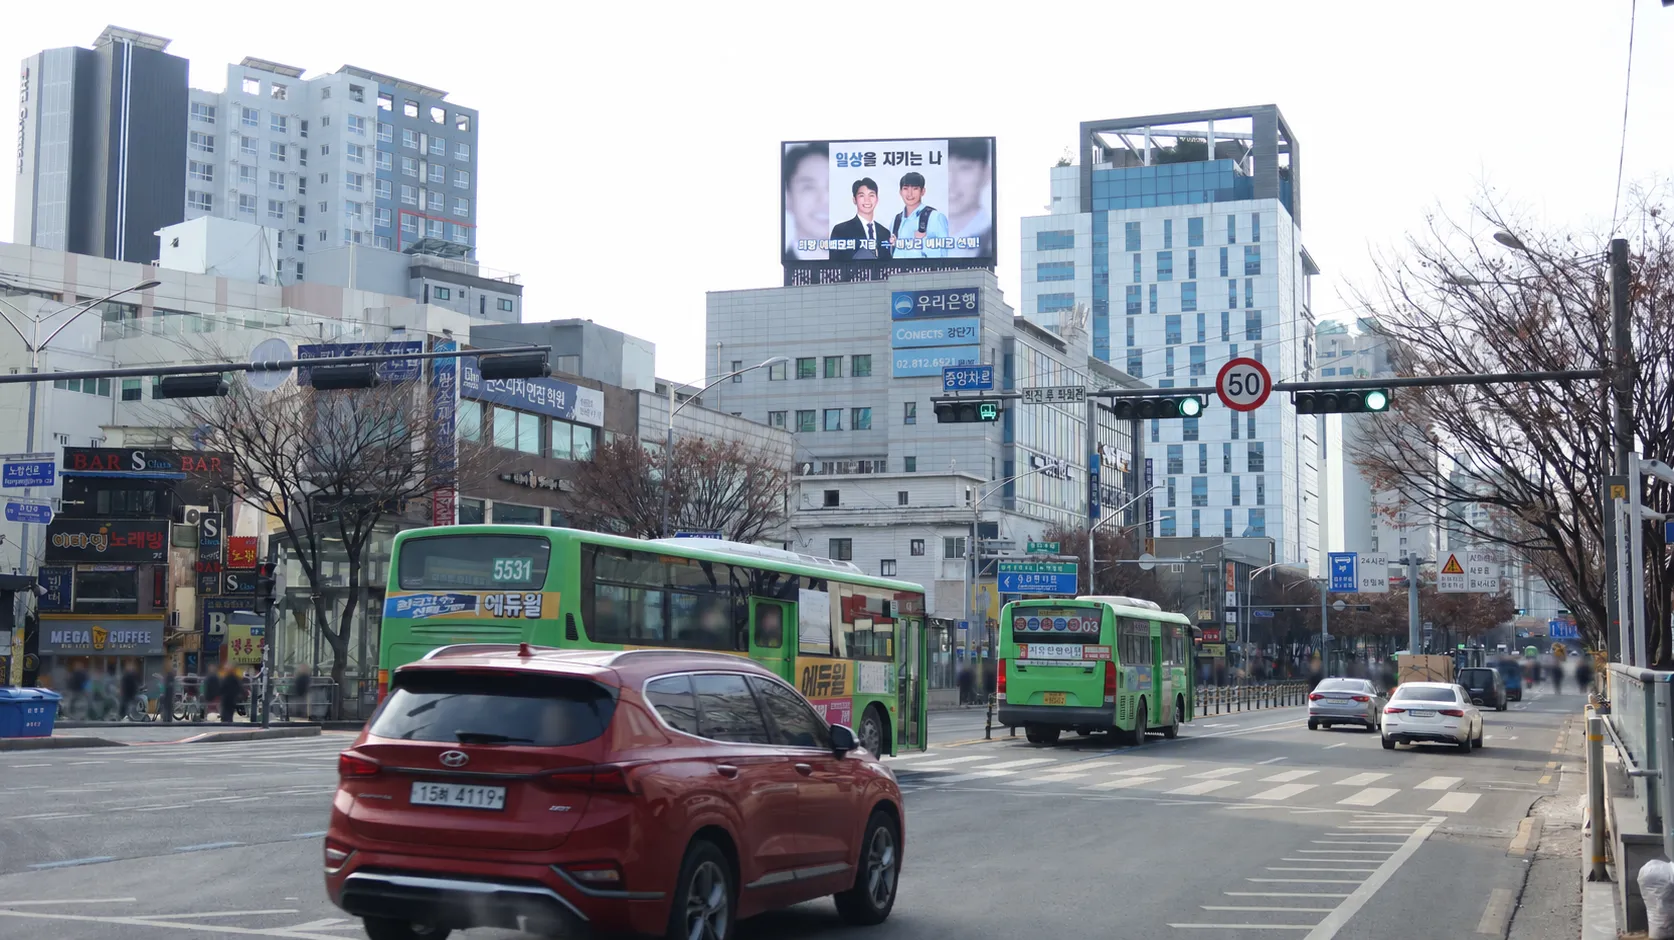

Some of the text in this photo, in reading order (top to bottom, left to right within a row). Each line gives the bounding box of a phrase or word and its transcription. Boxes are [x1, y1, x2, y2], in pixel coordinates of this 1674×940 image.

[835, 150, 943, 168] 일상을 지키는 나
[916, 292, 976, 312] 우리은행
[945, 370, 992, 387] 중앙차로
[1228, 373, 1260, 396] 50
[73, 453, 121, 470] BAR
[131, 450, 146, 471] S
[181, 456, 223, 473] BAR
[204, 518, 218, 537] S
[110, 531, 164, 551] 노래방
[493, 559, 532, 582] 5531
[1360, 557, 1385, 566] 24시간
[226, 574, 239, 591] S
[484, 593, 543, 619] 에듀윌
[1082, 620, 1099, 632] 03
[50, 630, 90, 644] MEGA
[109, 630, 151, 643] COFFEE
[801, 663, 847, 697] 에듀윌
[455, 788, 497, 806] 4119
